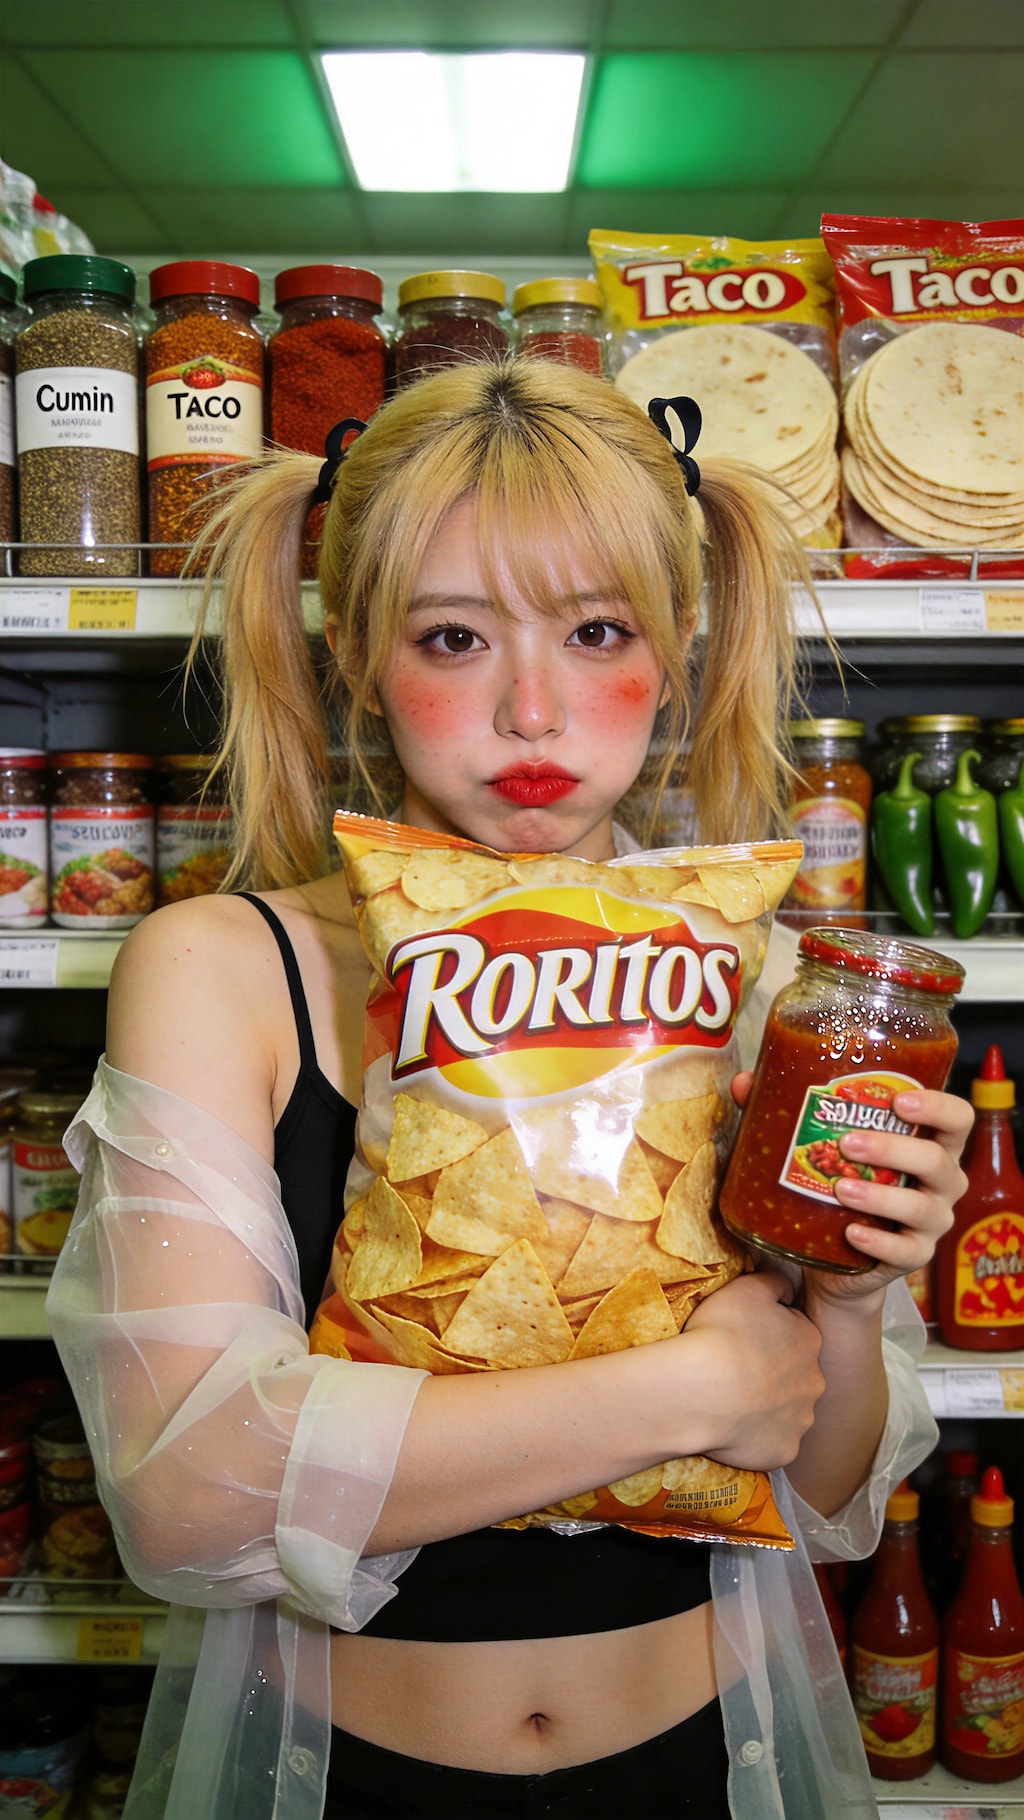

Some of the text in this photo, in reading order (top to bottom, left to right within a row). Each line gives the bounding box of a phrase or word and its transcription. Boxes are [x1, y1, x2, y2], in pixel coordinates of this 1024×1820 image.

[626, 262, 786, 318] Taco
[870, 257, 1024, 314] Taco
[36, 384, 114, 413] Cumin
[167, 392, 242, 420] TACO
